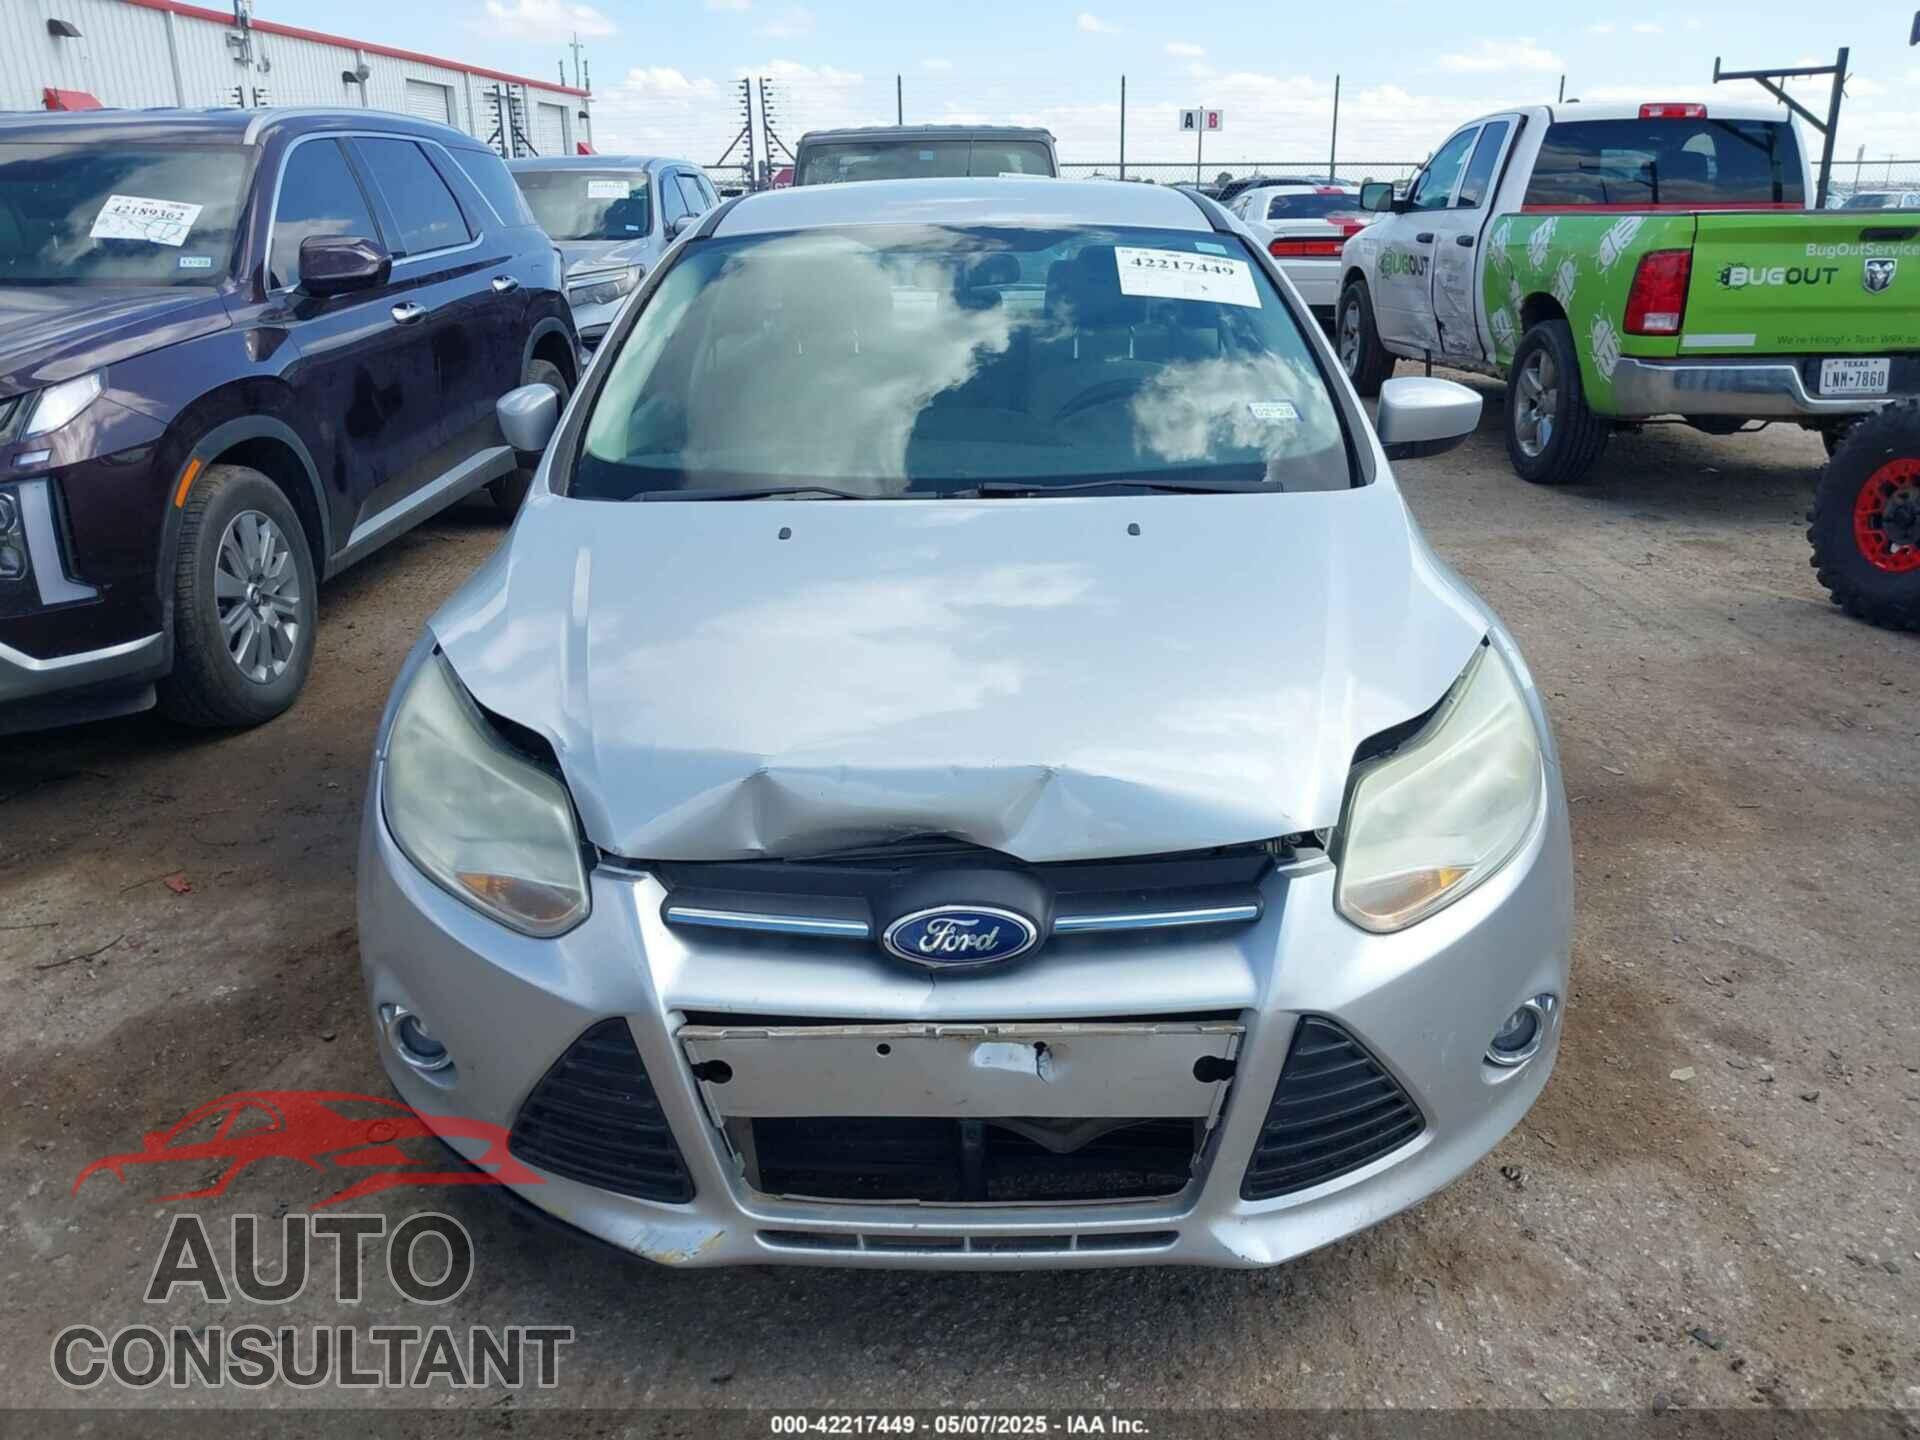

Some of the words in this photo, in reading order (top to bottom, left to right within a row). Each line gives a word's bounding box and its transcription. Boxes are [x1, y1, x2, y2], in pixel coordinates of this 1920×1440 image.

[1184, 112, 1194, 128] A
[1208, 112, 1218, 128] B
[1130, 257, 1236, 276] 42217449
[1729, 266, 1839, 286] BUGOUT
[1843, 360, 1869, 368] TEXAS
[919, 918, 1000, 952] Ford
